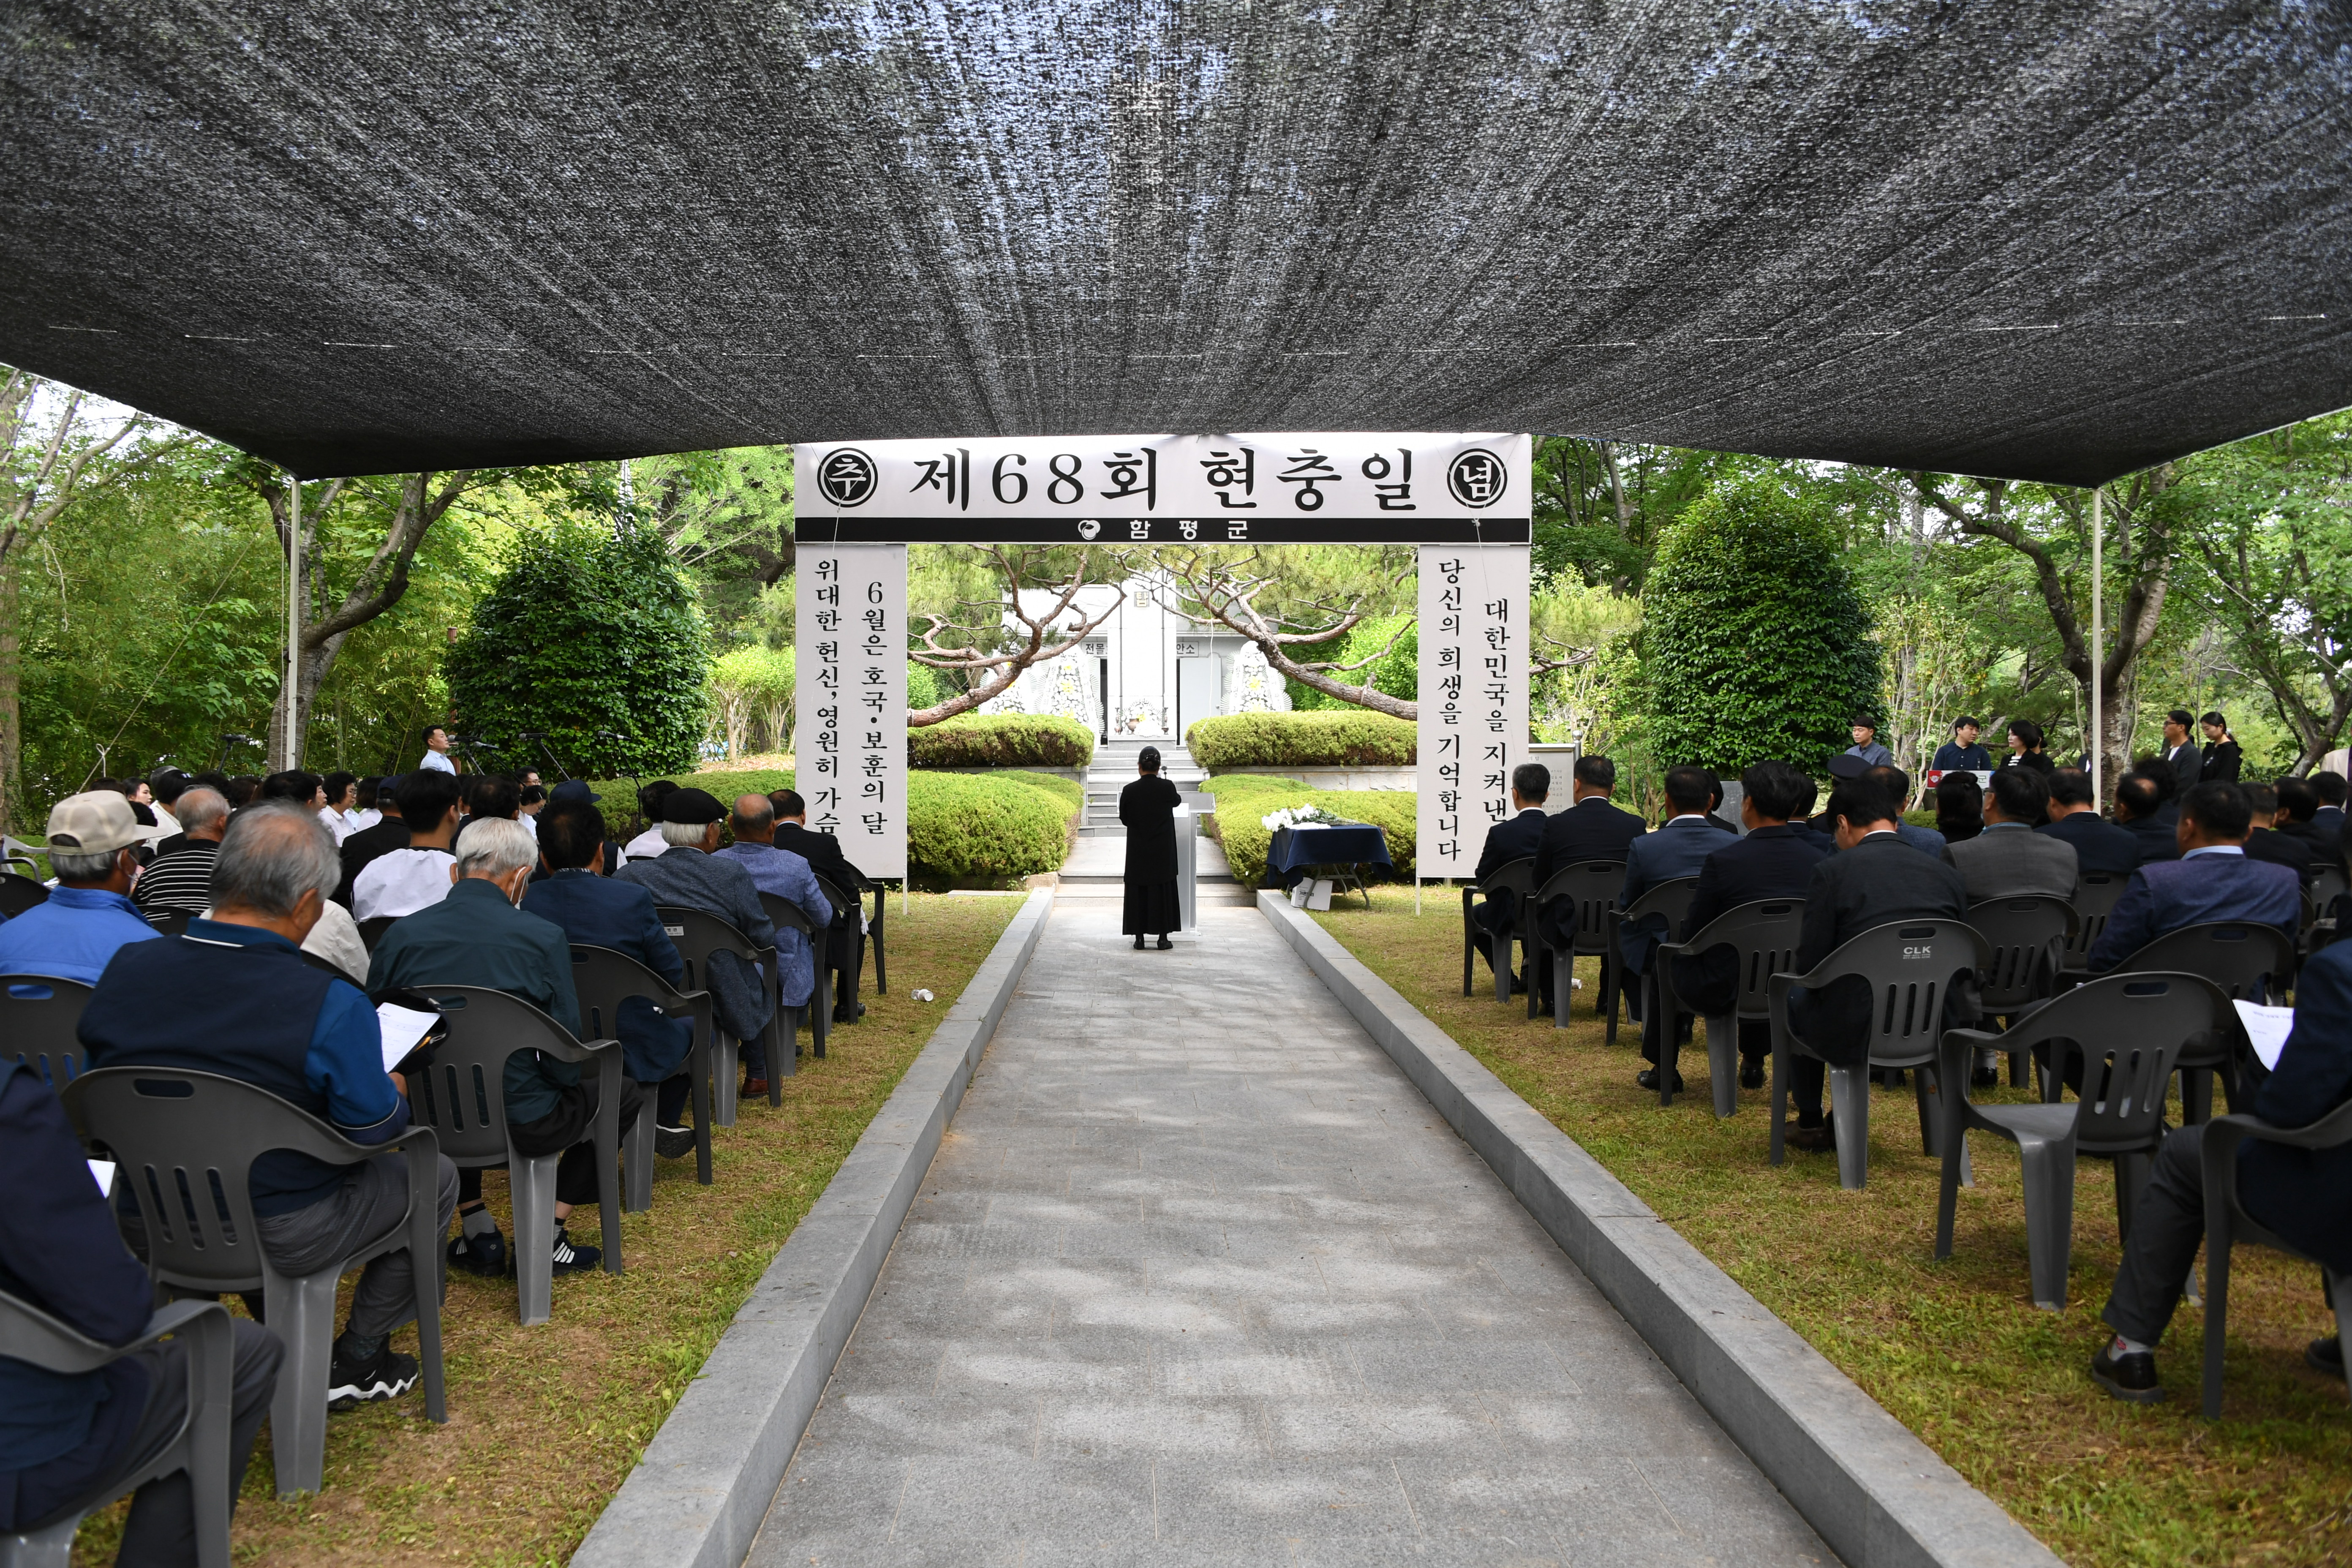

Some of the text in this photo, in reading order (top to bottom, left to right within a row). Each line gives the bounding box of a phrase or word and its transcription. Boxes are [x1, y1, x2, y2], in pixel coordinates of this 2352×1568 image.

[829, 458, 866, 497] 추
[909, 447, 1416, 512] 제68회 현충일
[1459, 460, 1496, 499] 념
[1130, 520, 1248, 540] 함평군
[814, 559, 842, 632] 위대한
[1136, 592, 1149, 607] 탑
[861, 582, 887, 656] 6월은
[1086, 643, 1107, 654] 전몰
[1437, 558, 1465, 861] 당신의 희생을 기억합니다
[1483, 598, 1511, 822] 대한민국을 지켜낸
[815, 705, 839, 779] 영원히
[861, 811, 887, 834] 달
[1903, 946, 1931, 954] CLK
